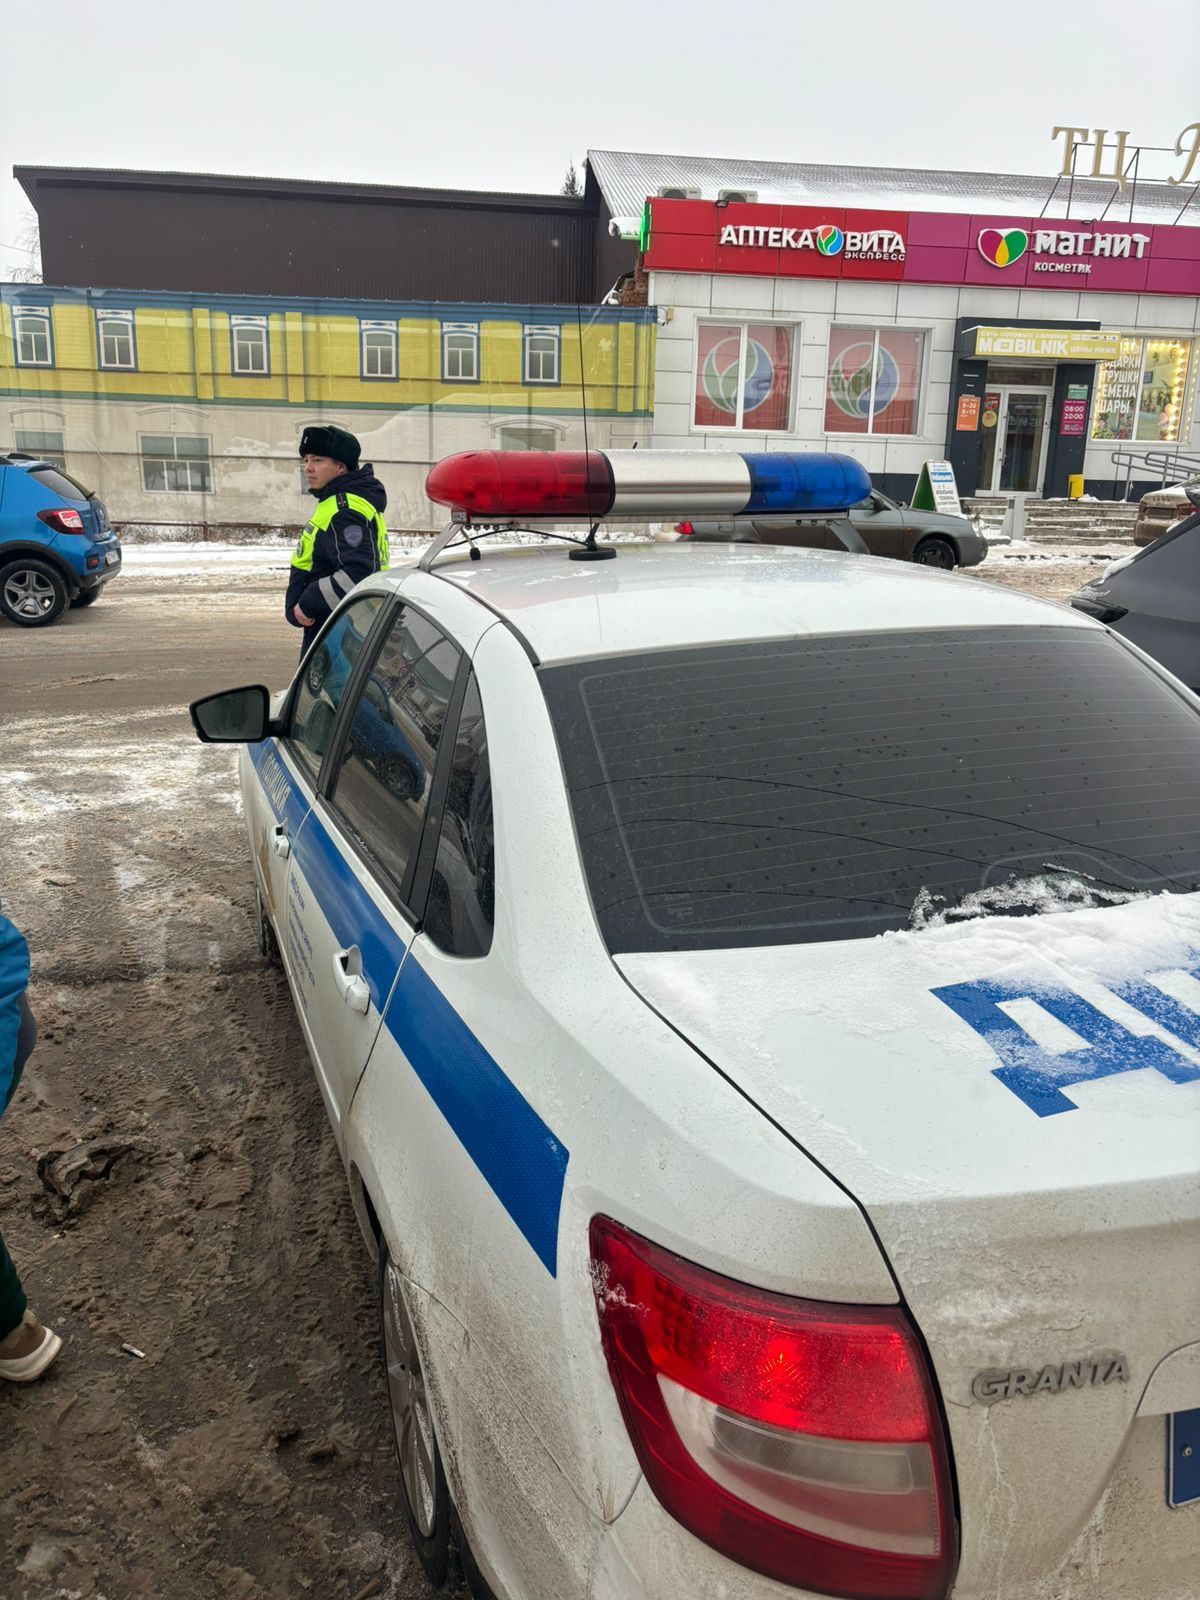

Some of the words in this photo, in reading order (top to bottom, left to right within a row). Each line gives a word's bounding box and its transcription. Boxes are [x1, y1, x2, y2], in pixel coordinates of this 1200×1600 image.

[1051, 126, 1131, 192] ТЦ
[719, 224, 815, 250] АПТЕКА
[844, 231, 906, 254] ВИТА
[844, 250, 906, 262] ЭКСПРЕСС
[1096, 399, 1130, 414] ШАРЫ
[971, 1351, 1131, 1403] GRANTA
